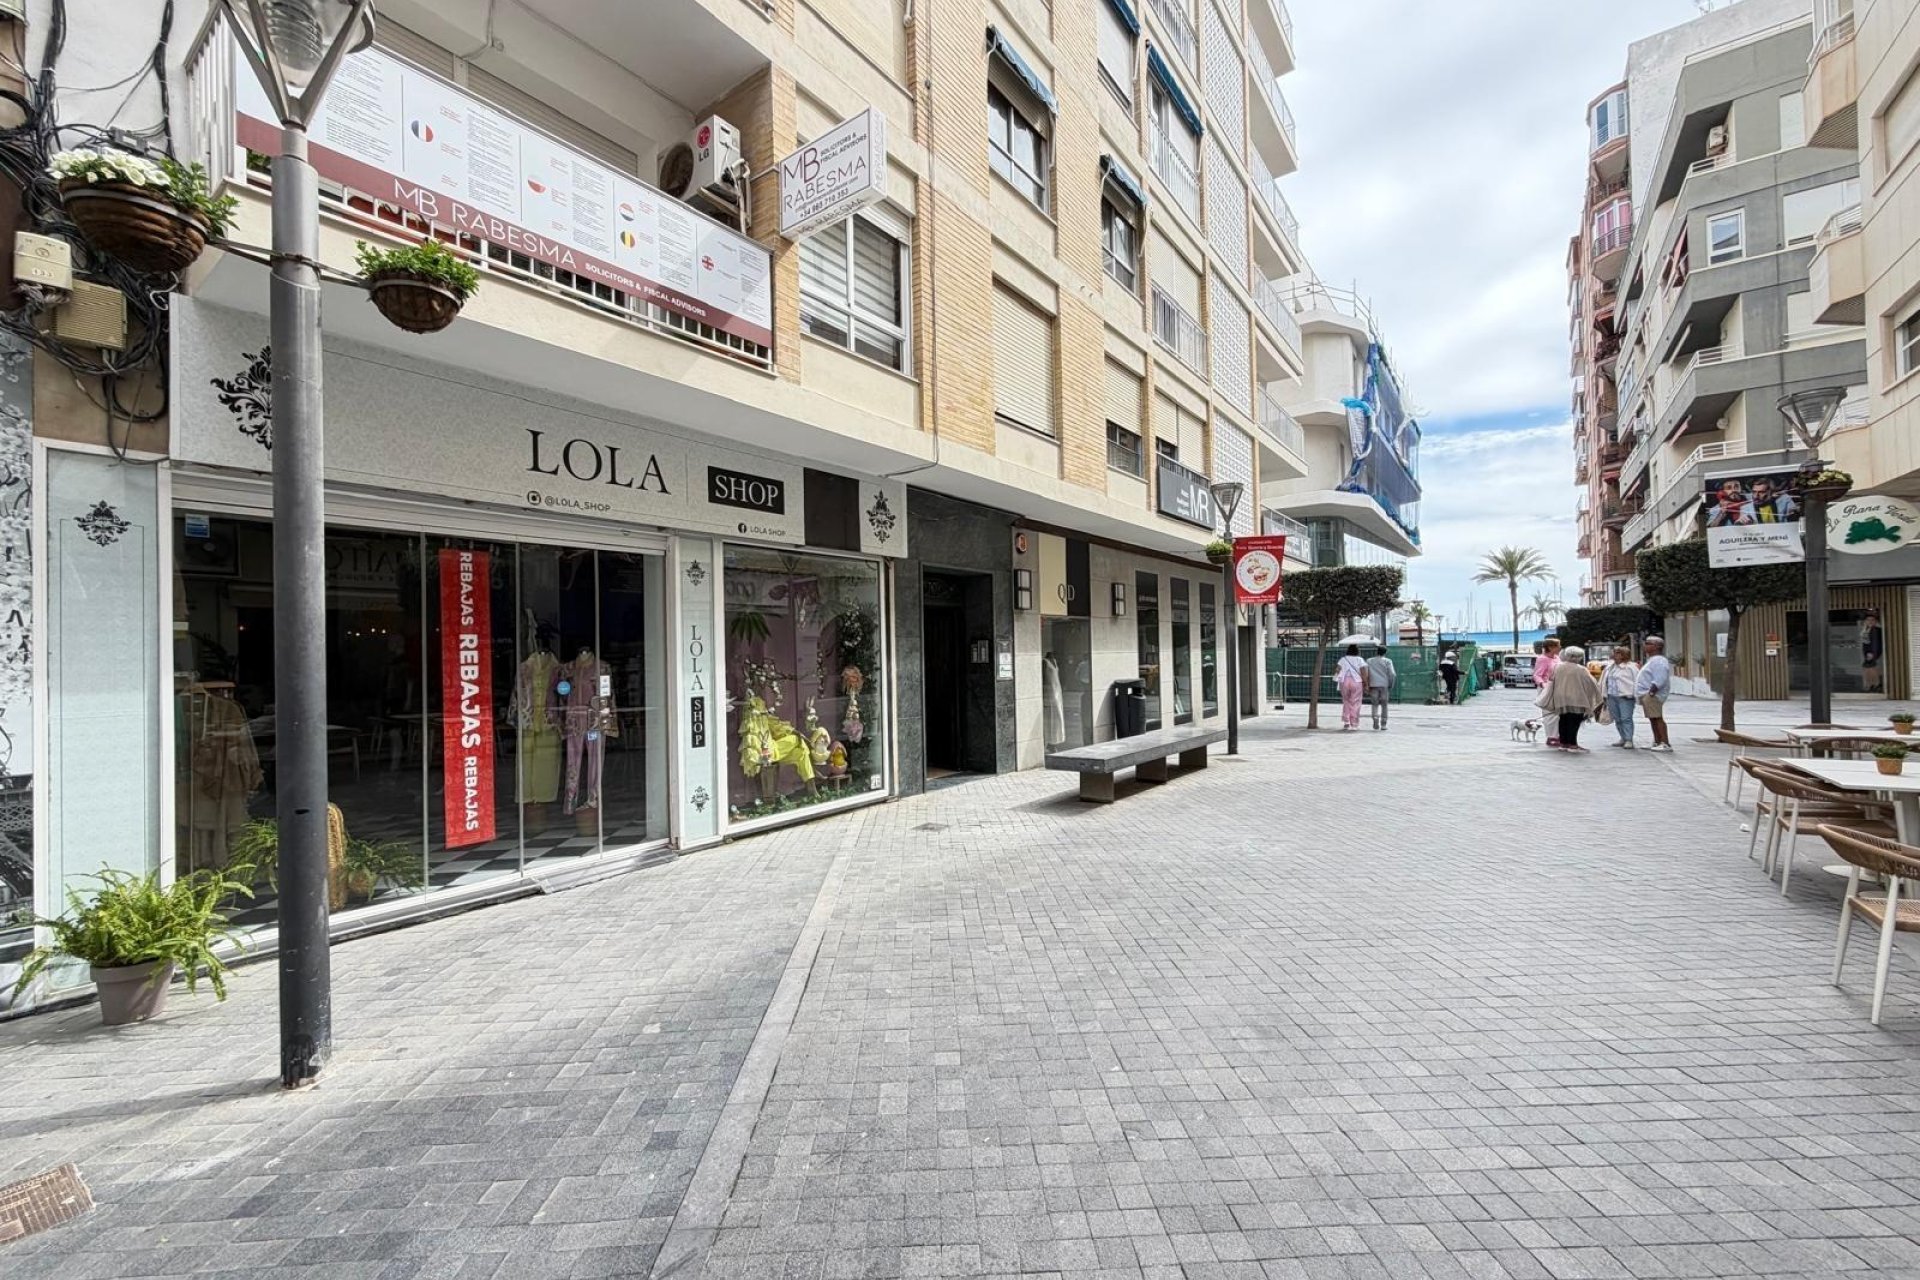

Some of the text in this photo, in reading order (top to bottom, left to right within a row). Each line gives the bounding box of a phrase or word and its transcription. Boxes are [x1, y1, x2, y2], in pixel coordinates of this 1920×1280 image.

[698, 147, 710, 162] LG
[784, 147, 821, 189] MB
[784, 155, 866, 213] RABESMA
[394, 178, 707, 317] MB RABESMA SOLICITORS & FISCAL ADVISORS
[525, 428, 779, 508] LOLA SHOP
[544, 495, 611, 512] @LOLA_SHOP
[750, 525, 787, 537] LOLA SHOP
[1842, 504, 1881, 519] Rana
[460, 552, 474, 627] REBAJAS
[459, 633, 481, 749] REBAJAS
[690, 625, 704, 746] LOLA SHOP
[464, 755, 479, 831] REBAJAS
